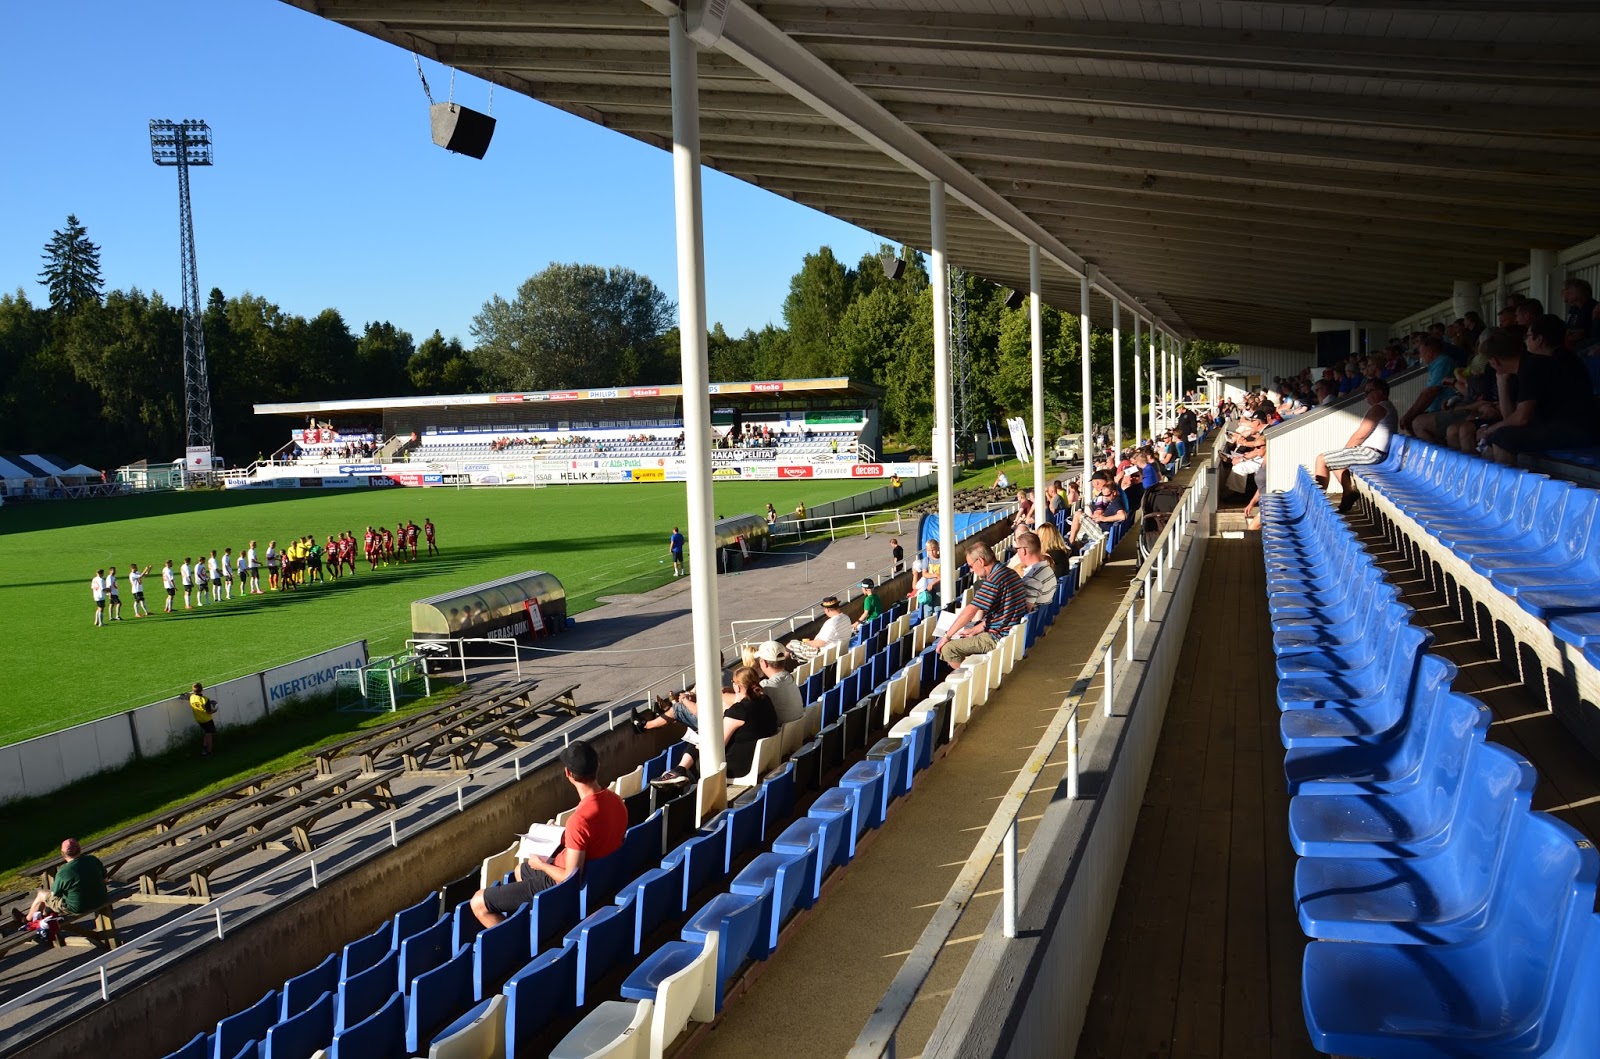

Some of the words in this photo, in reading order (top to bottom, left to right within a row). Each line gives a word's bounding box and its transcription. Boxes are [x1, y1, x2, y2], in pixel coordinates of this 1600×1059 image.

[590, 390, 616, 398] PHILIPS
[711, 451, 733, 459] HAKA
[609, 459, 642, 468] Alfa-Putki
[855, 465, 880, 475] decens
[560, 472, 588, 480] HELIK
[371, 476, 395, 486] habo
[487, 620, 530, 639] VIERASJOUK
[269, 657, 363, 701] KIERTOKAPULA
